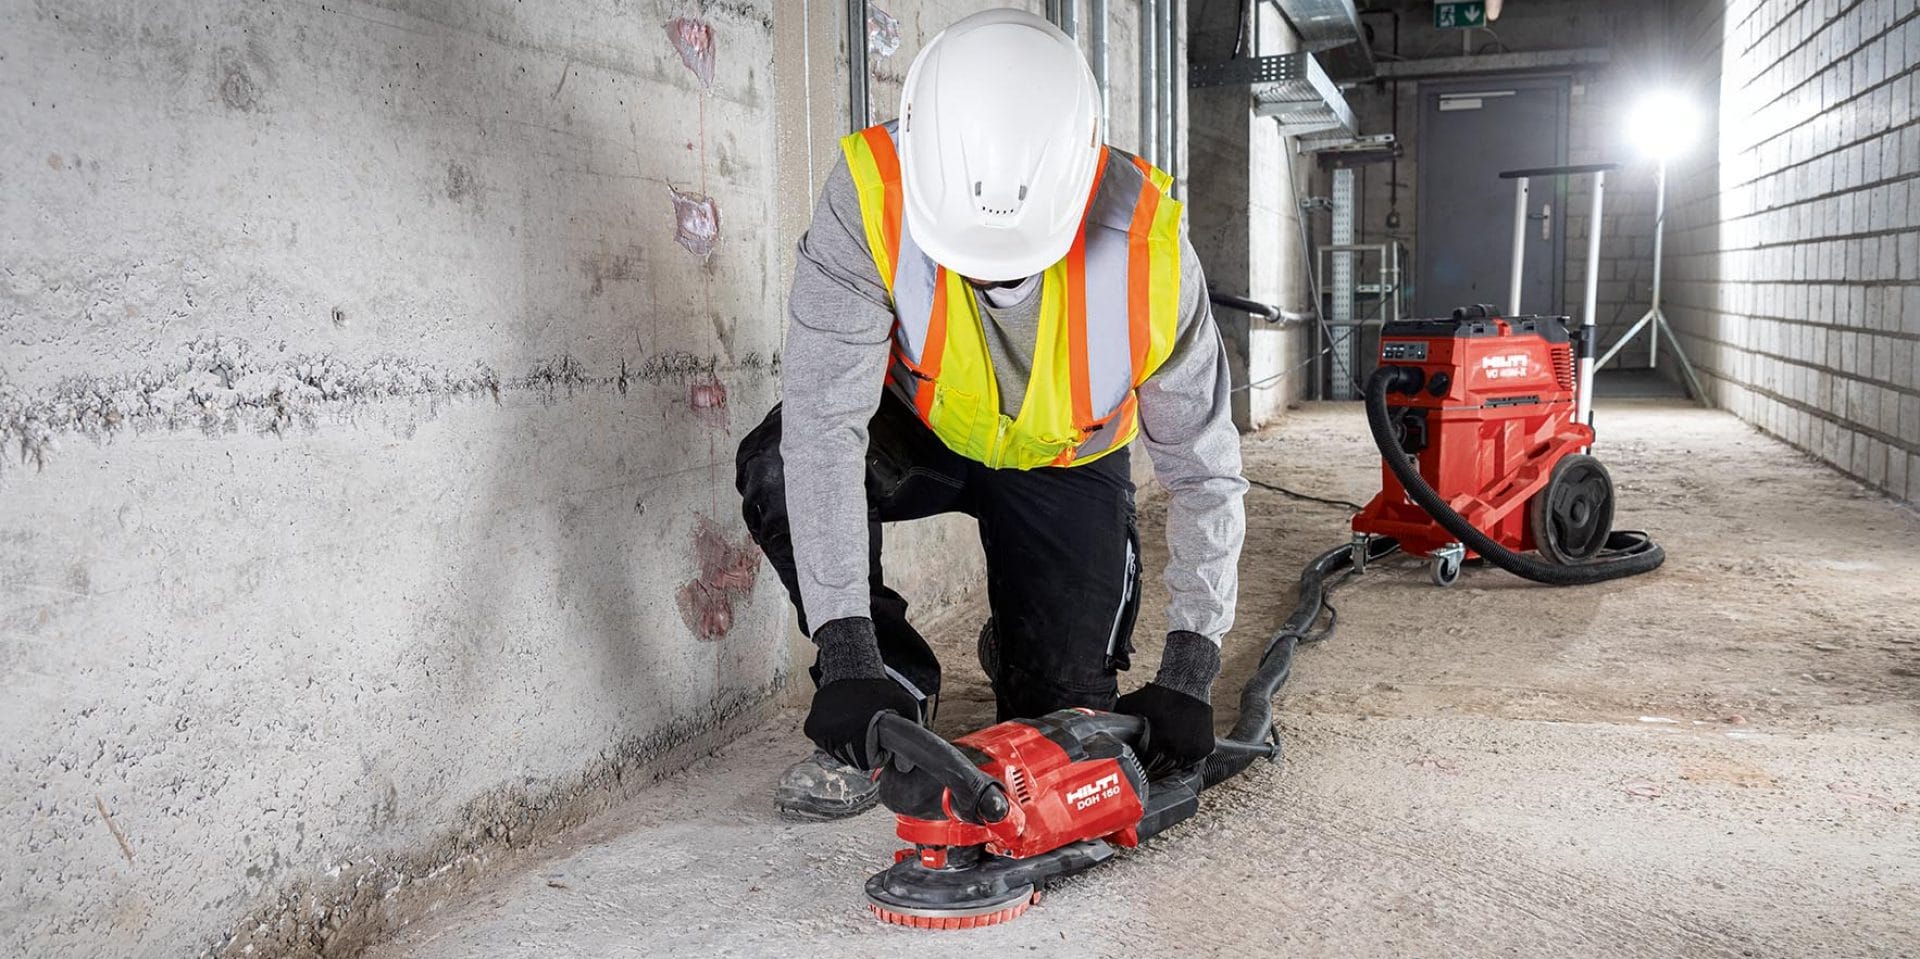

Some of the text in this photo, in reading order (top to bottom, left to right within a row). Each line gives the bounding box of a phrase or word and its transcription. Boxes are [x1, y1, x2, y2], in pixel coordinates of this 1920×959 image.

[1481, 354, 1528, 369] HILTI
[1066, 773, 1119, 804] HILTI
[1077, 793, 1100, 811] DGH
